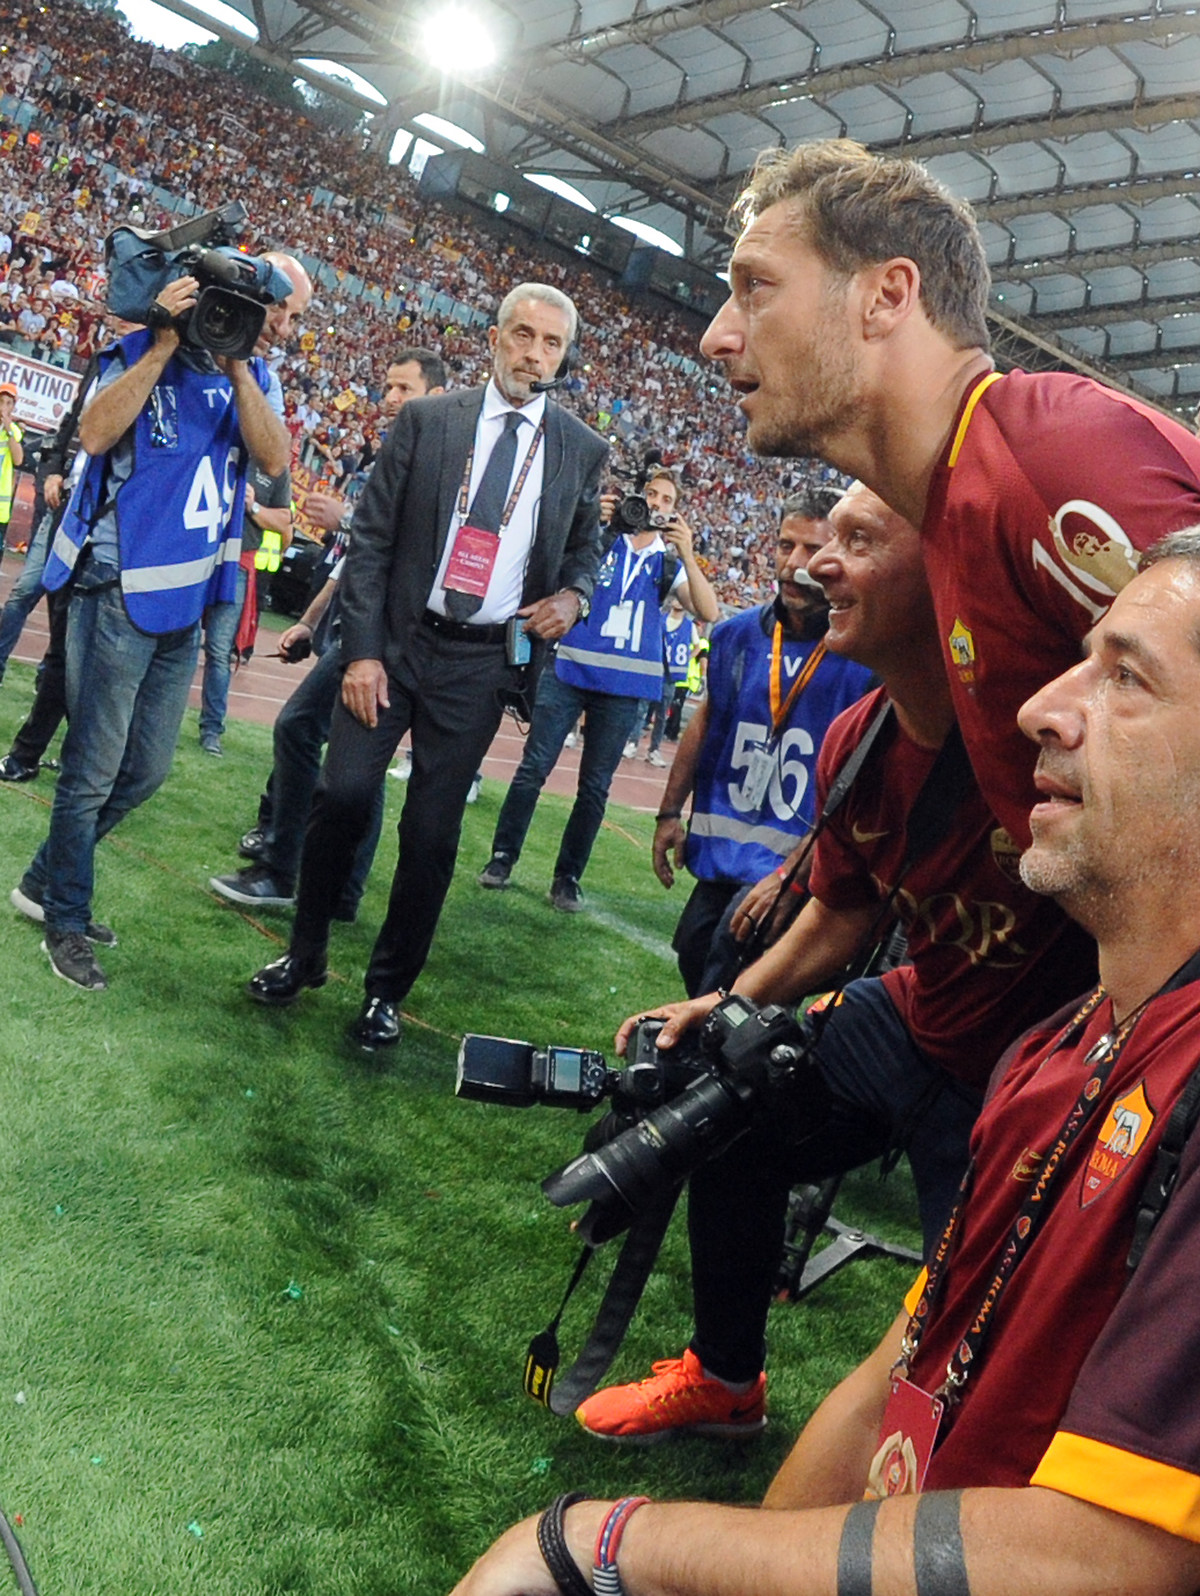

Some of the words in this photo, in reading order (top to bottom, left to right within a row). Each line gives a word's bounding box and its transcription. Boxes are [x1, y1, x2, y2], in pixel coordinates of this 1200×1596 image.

[0, 360, 74, 403] RENTINO
[183, 446, 240, 544] 49
[600, 599, 645, 653] 41
[766, 653, 803, 677] V
[728, 721, 814, 821] 56
[1089, 1150, 1119, 1180] ROMA
